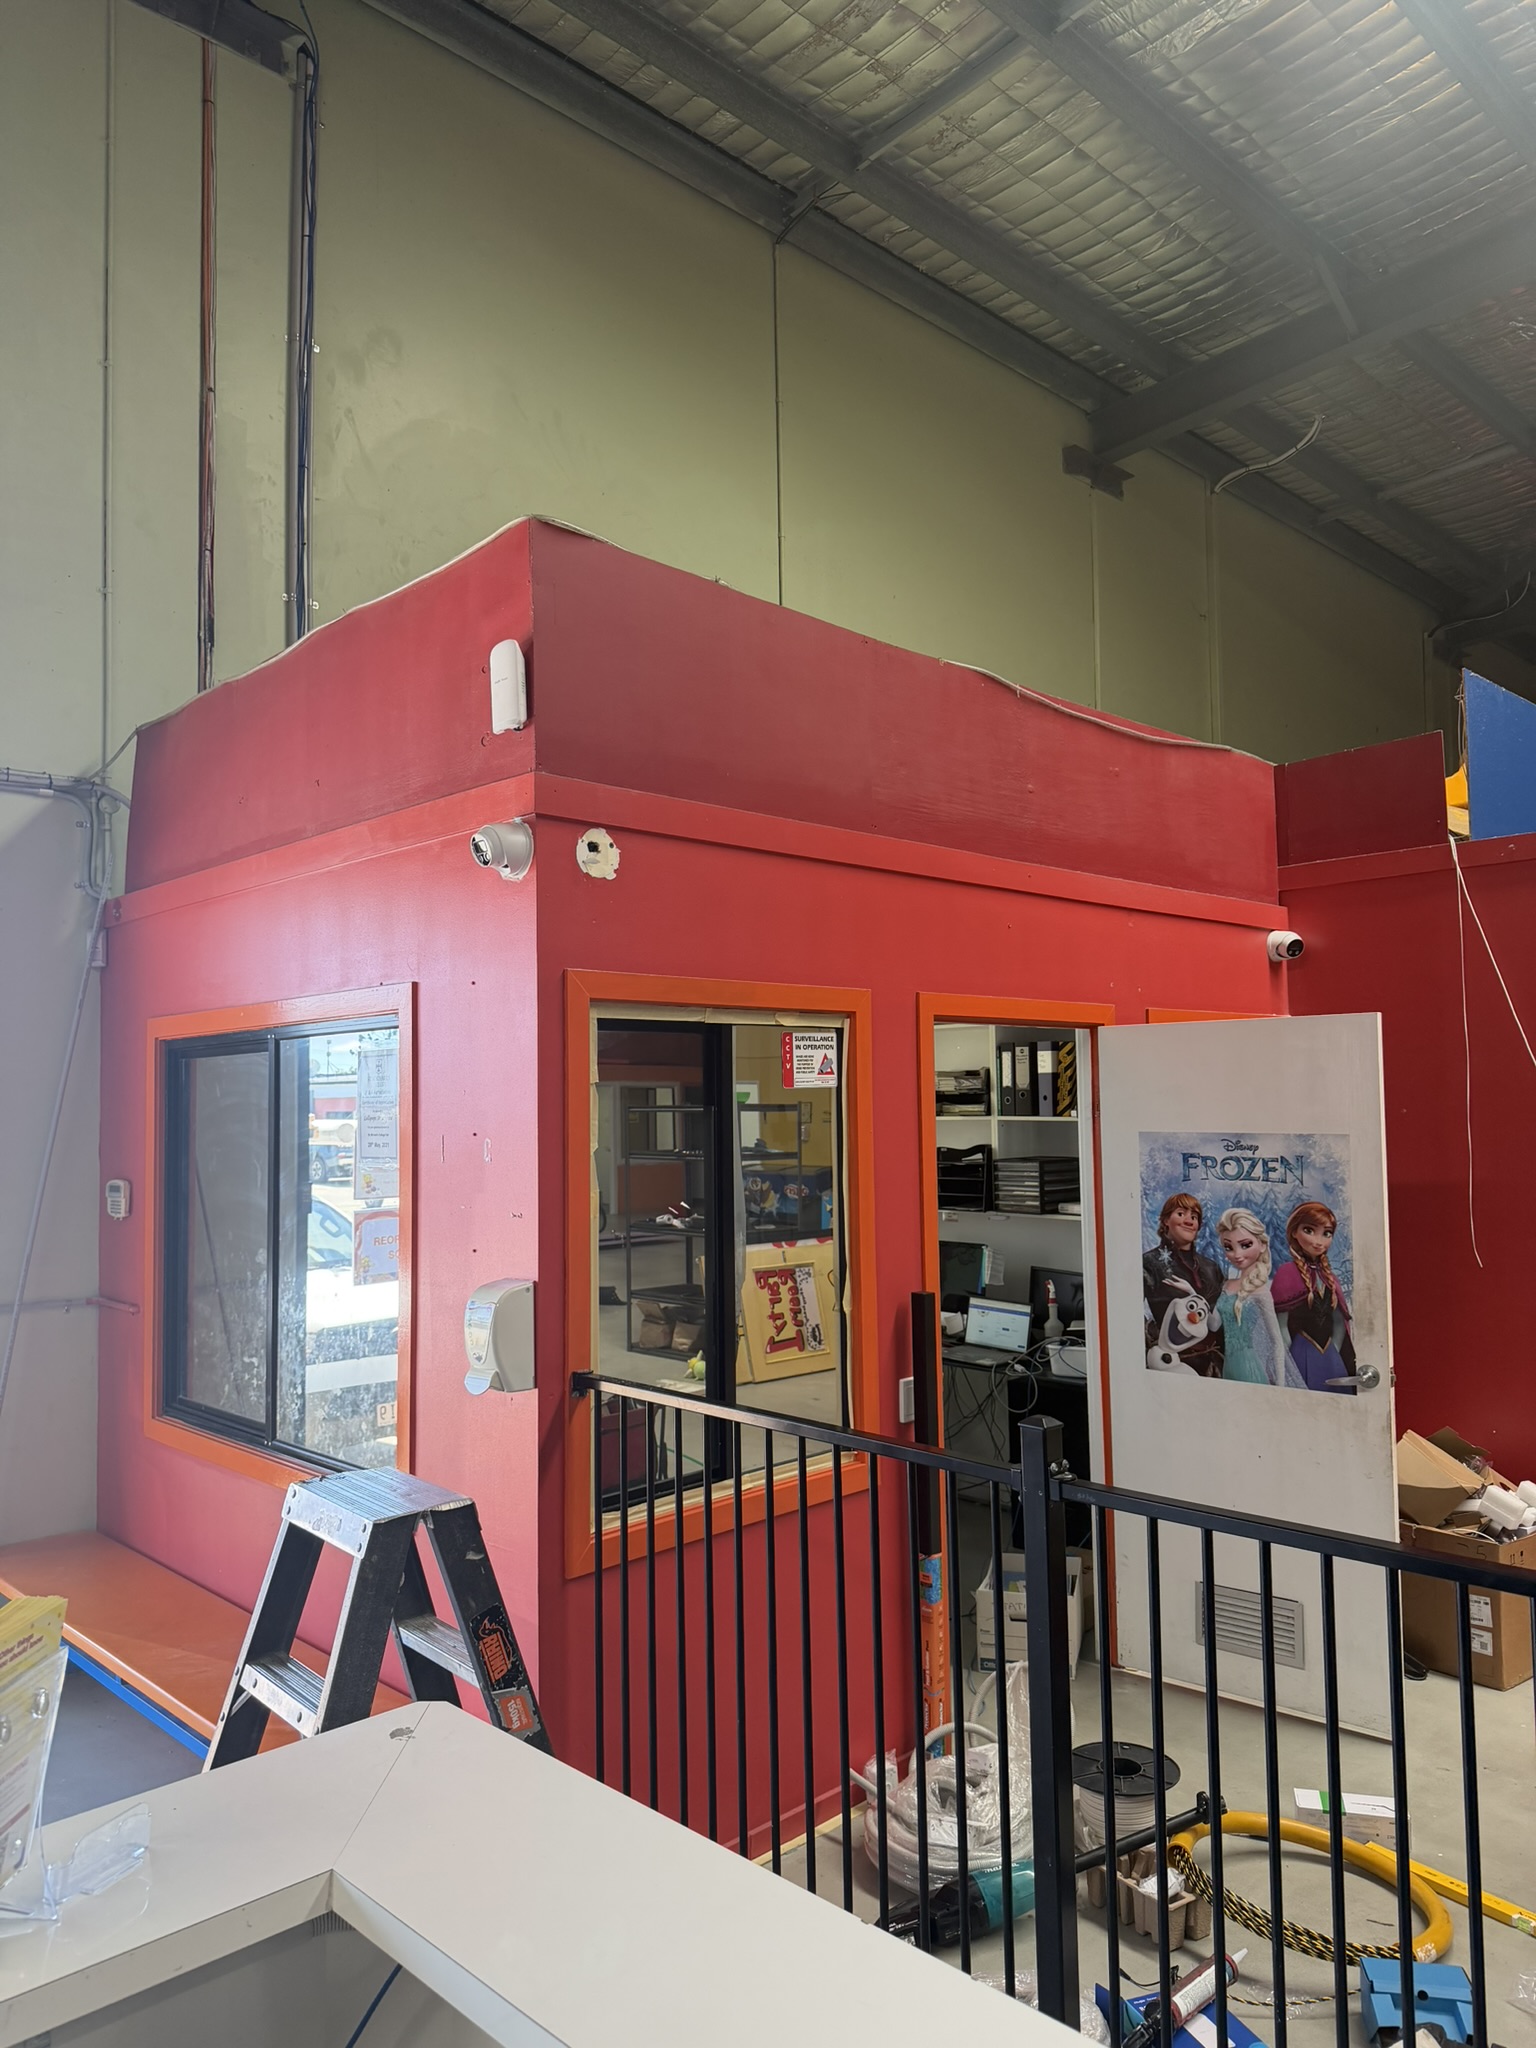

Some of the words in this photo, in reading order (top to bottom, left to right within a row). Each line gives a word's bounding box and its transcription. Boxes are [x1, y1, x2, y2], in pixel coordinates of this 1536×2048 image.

[1221, 1138, 1259, 1155] Disney
[1180, 1152, 1304, 1186] FROZEN
[483, 1634, 508, 1681] RHINO
